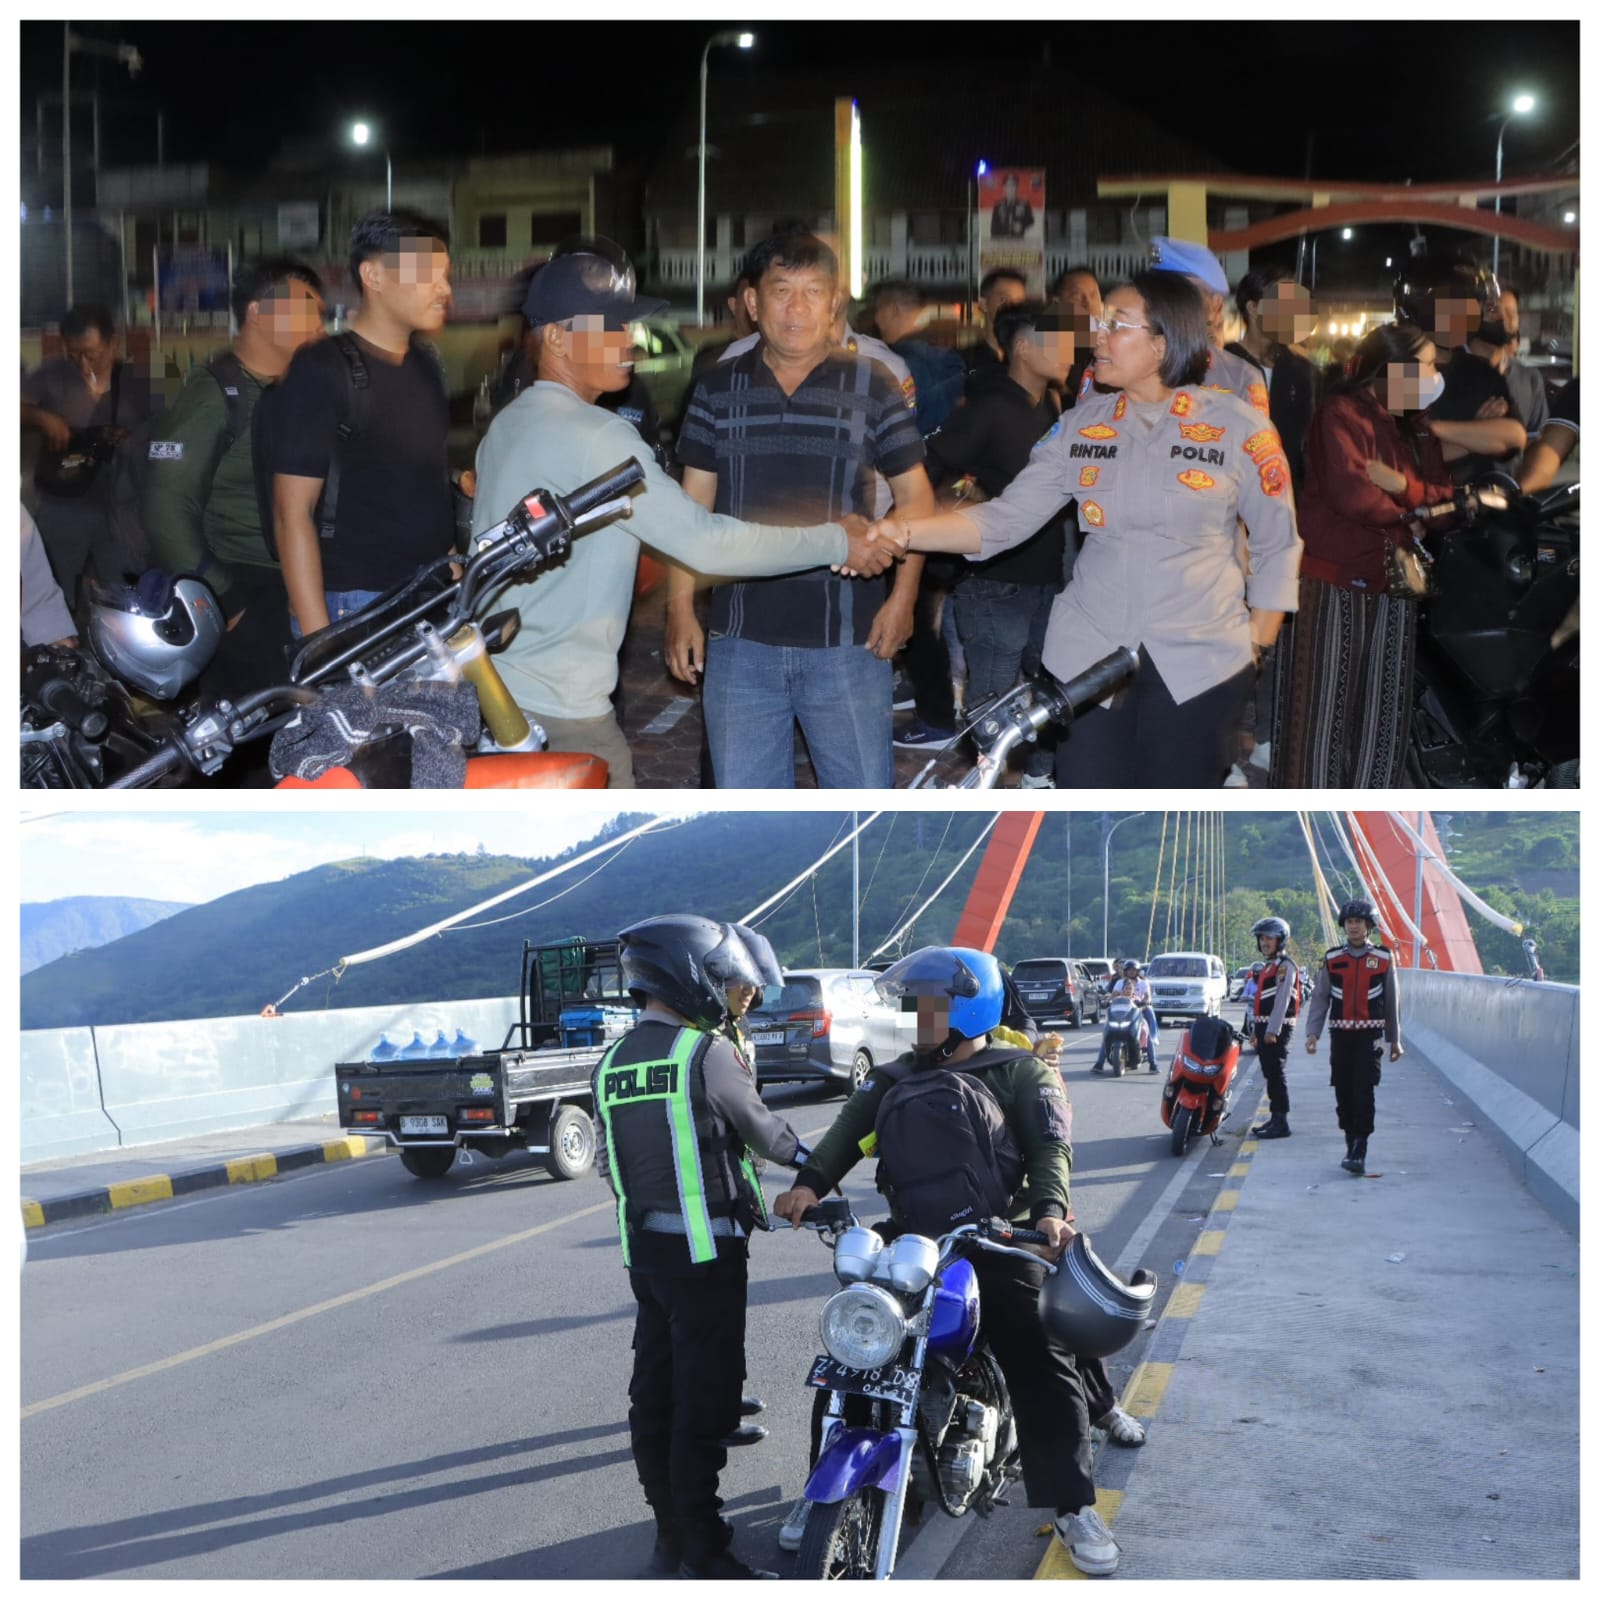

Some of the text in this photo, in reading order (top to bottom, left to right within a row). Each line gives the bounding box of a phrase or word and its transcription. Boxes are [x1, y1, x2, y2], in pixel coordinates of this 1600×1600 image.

[1069, 443, 1118, 459] RINTAR
[1170, 445, 1225, 466] POLRI
[604, 1064, 679, 1102] POLISI
